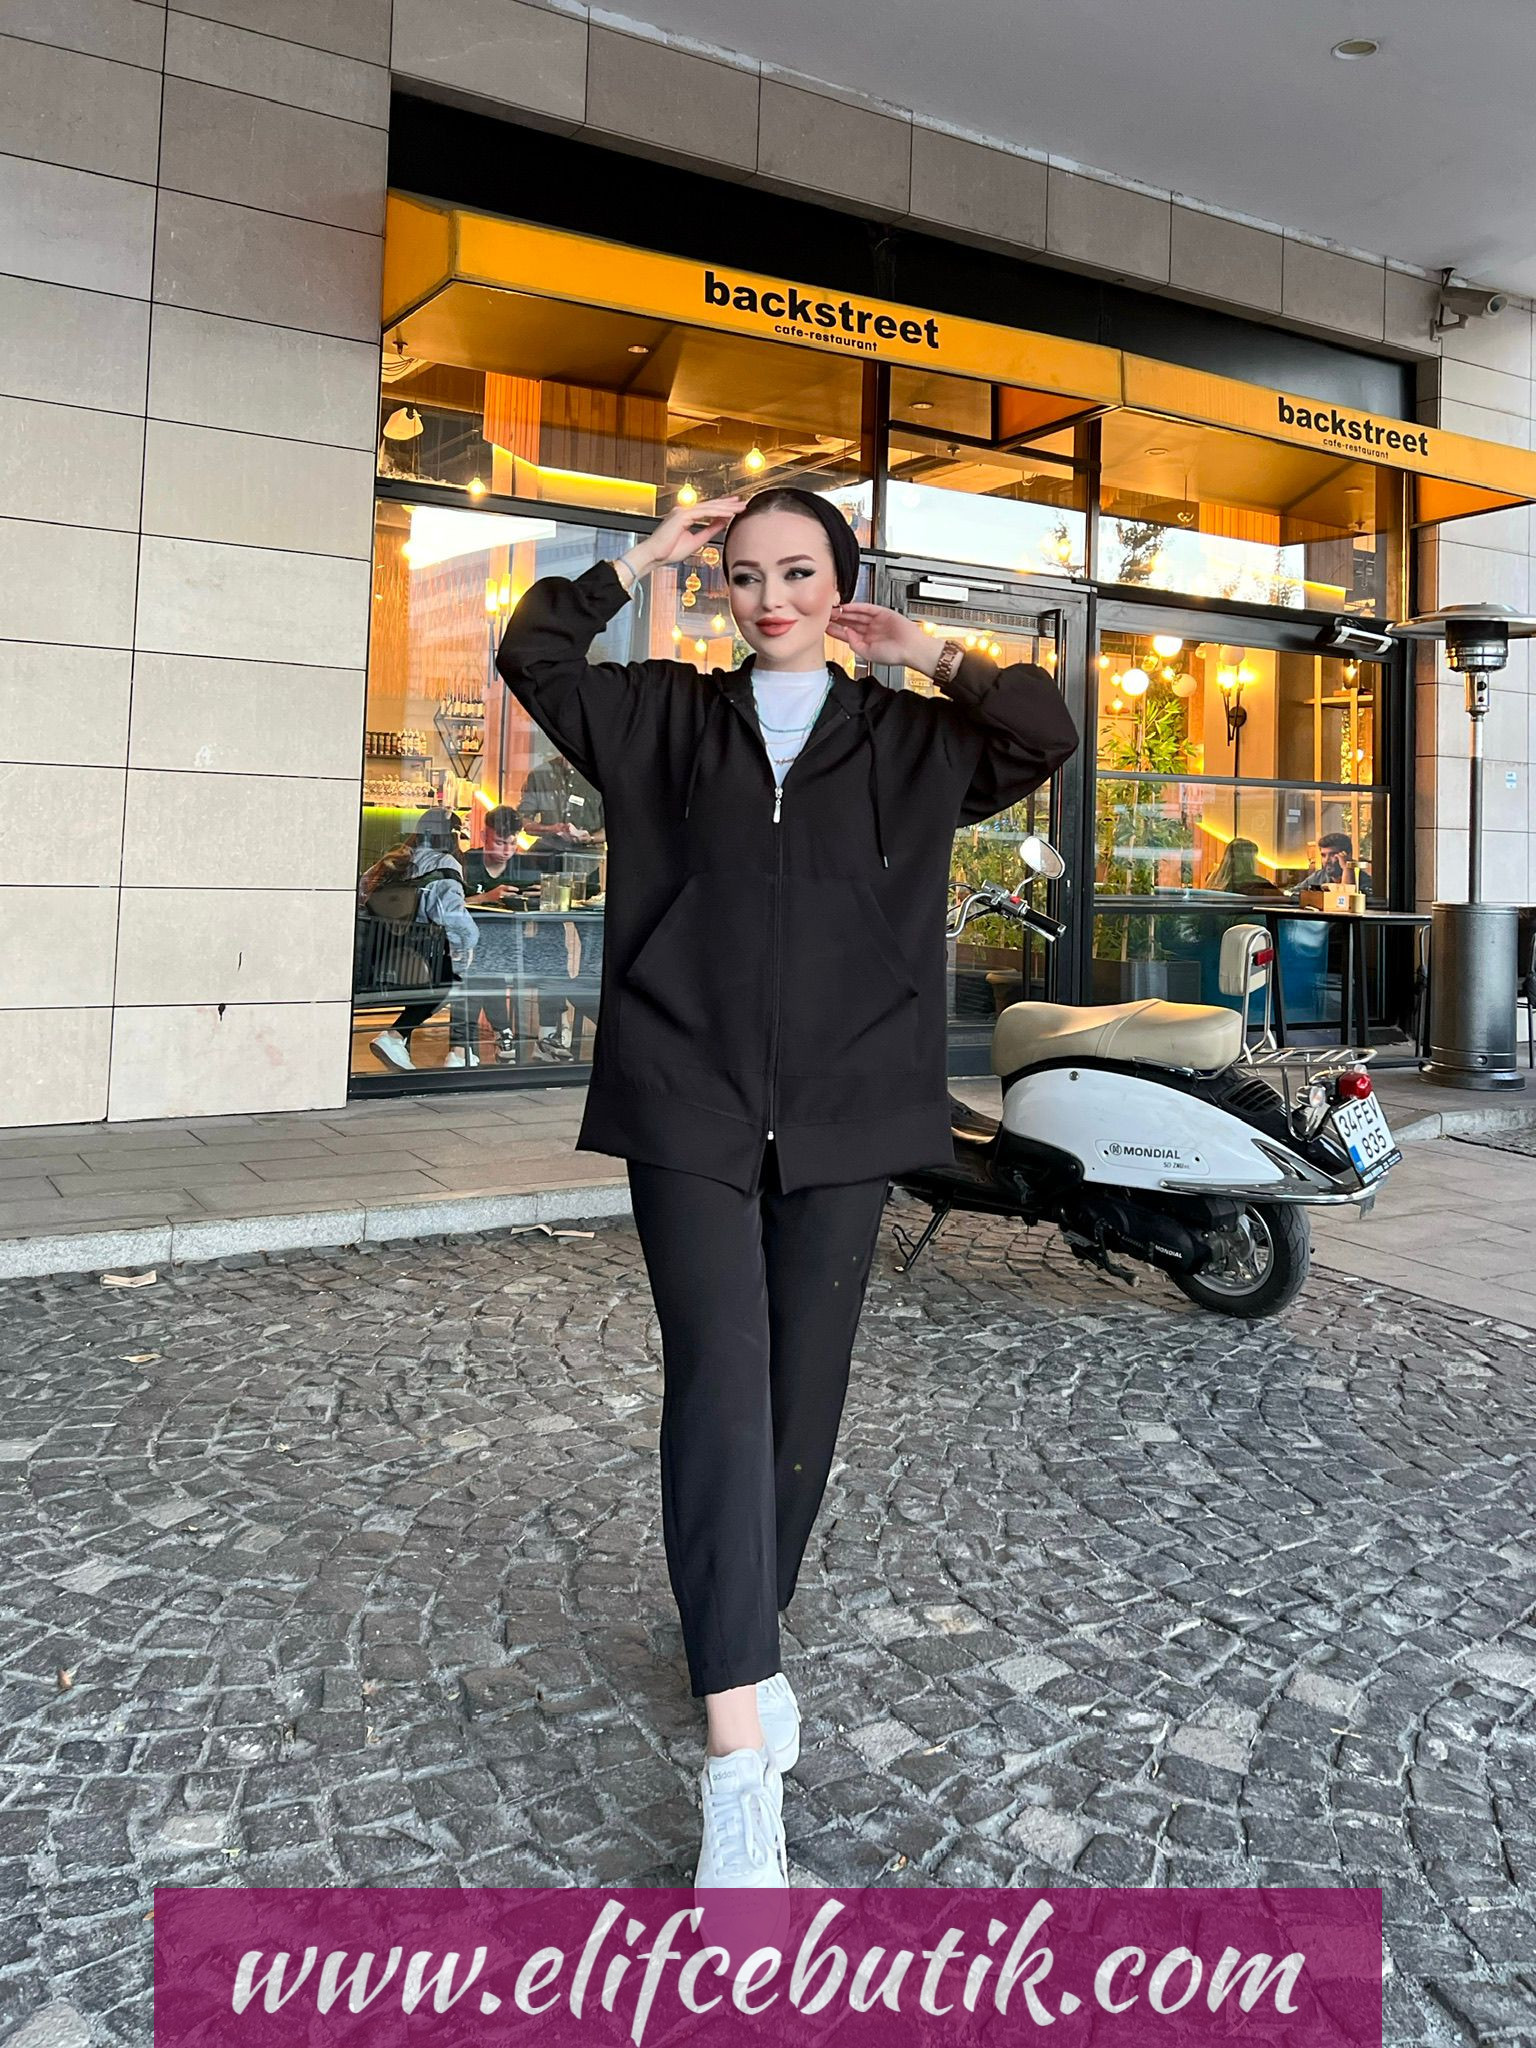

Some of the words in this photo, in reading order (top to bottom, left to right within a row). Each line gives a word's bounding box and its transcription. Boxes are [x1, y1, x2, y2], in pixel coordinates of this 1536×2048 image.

[704, 270, 940, 350] backstreet
[774, 323, 878, 352] cafe-restaurant
[1278, 396, 1429, 456] backstreet
[1322, 437, 1389, 460] cafe-restaurant
[1123, 1146, 1181, 1160] MONDIAL
[1361, 1127, 1387, 1159] 835
[1154, 1244, 1183, 1259] MONDIAL
